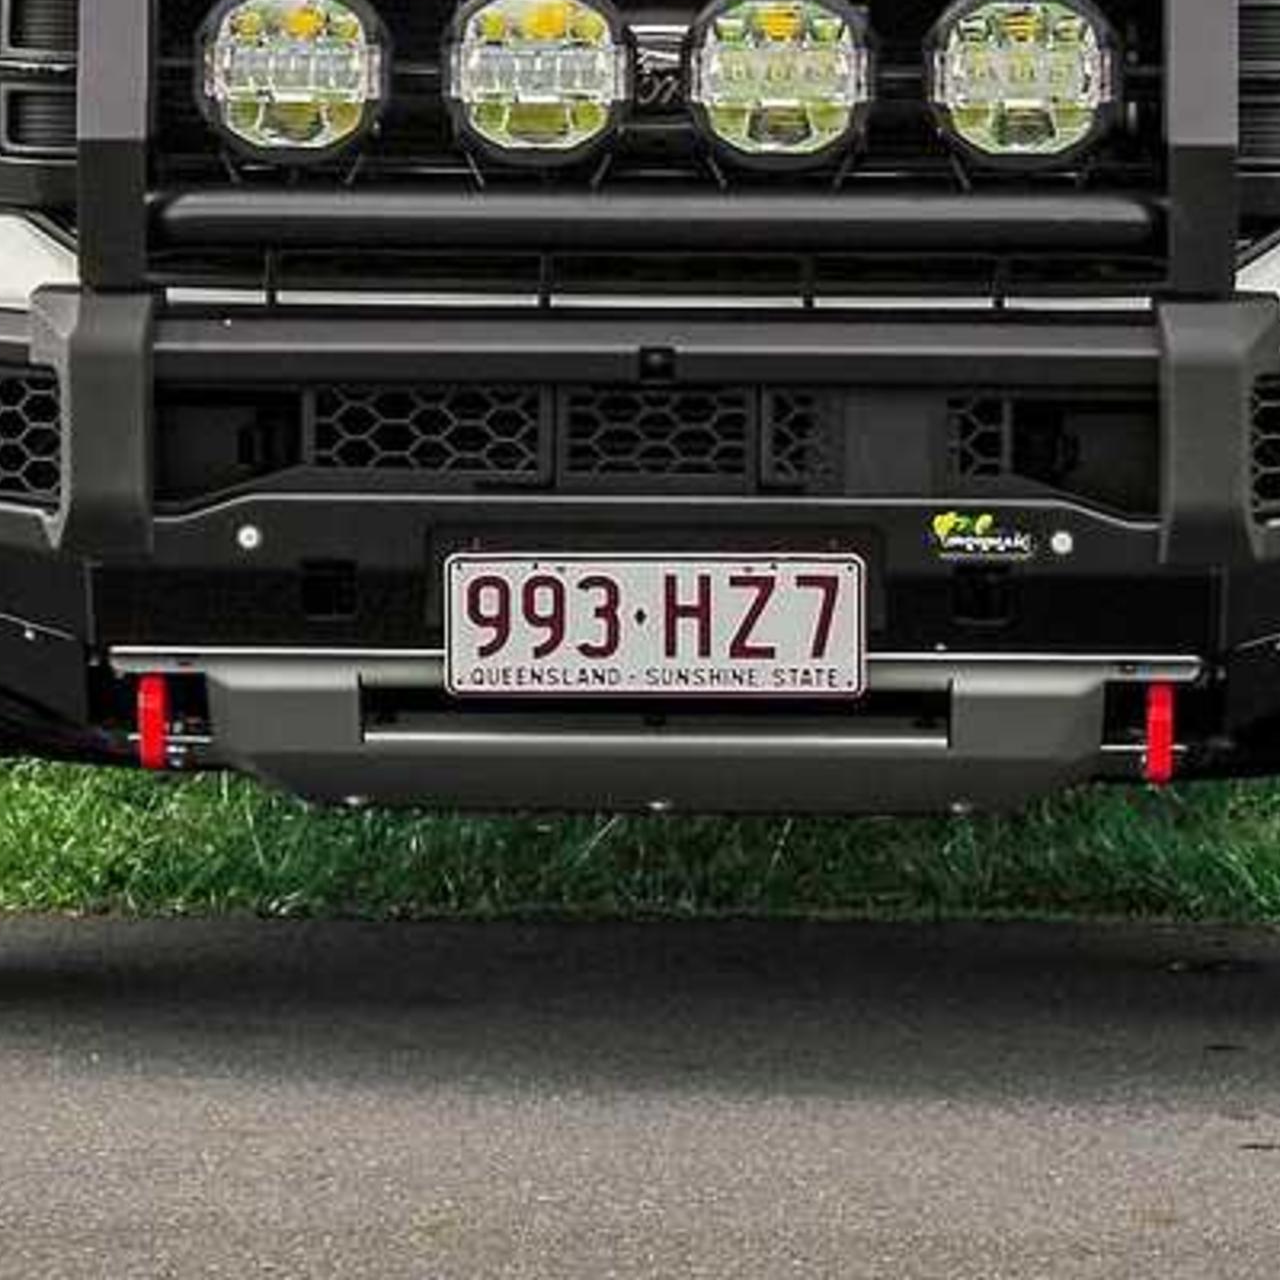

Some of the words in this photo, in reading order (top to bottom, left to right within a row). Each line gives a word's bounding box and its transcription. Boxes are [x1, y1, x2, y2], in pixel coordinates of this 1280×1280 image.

[471, 668, 620, 686] QUEENSLAND
[646, 669, 757, 687] SUNSHINE
[773, 669, 840, 688] STATE
